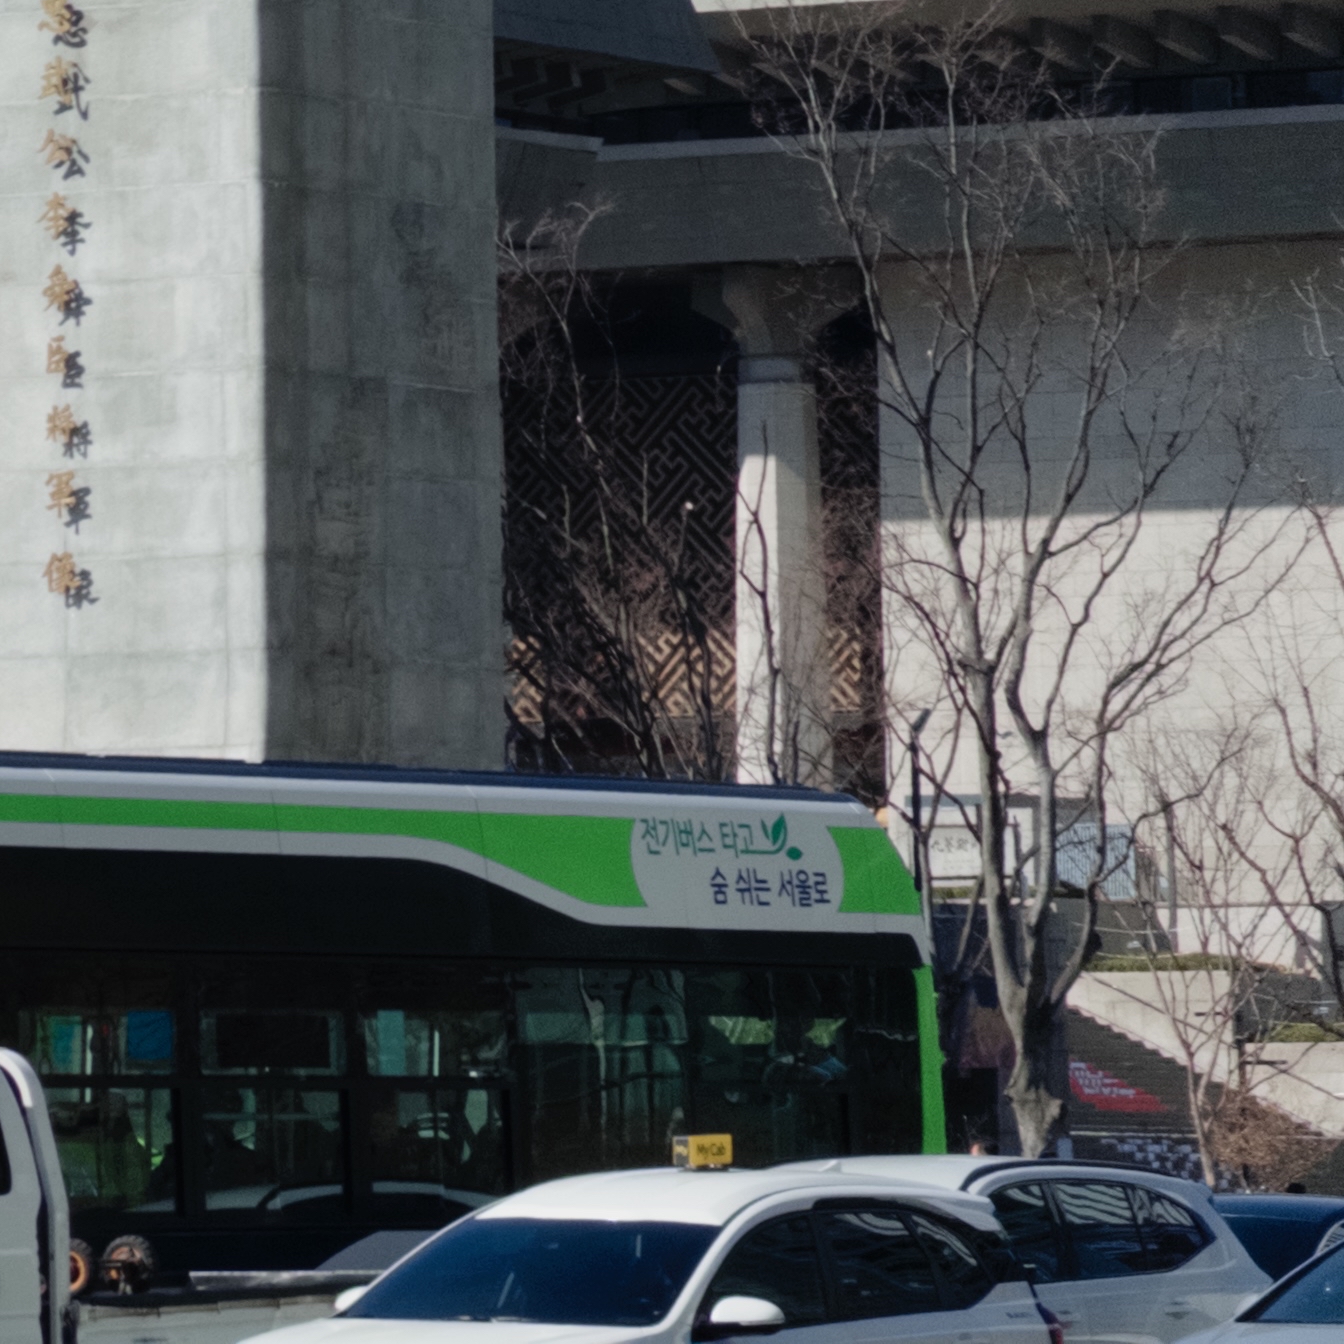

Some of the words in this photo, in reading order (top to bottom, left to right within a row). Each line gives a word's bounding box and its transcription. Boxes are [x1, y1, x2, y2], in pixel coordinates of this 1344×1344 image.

[639, 817, 716, 857] 전기버스
[719, 820, 759, 858] 타고
[710, 867, 729, 905] 숨
[735, 868, 772, 907] 쉬는
[778, 869, 832, 908] 서울로
